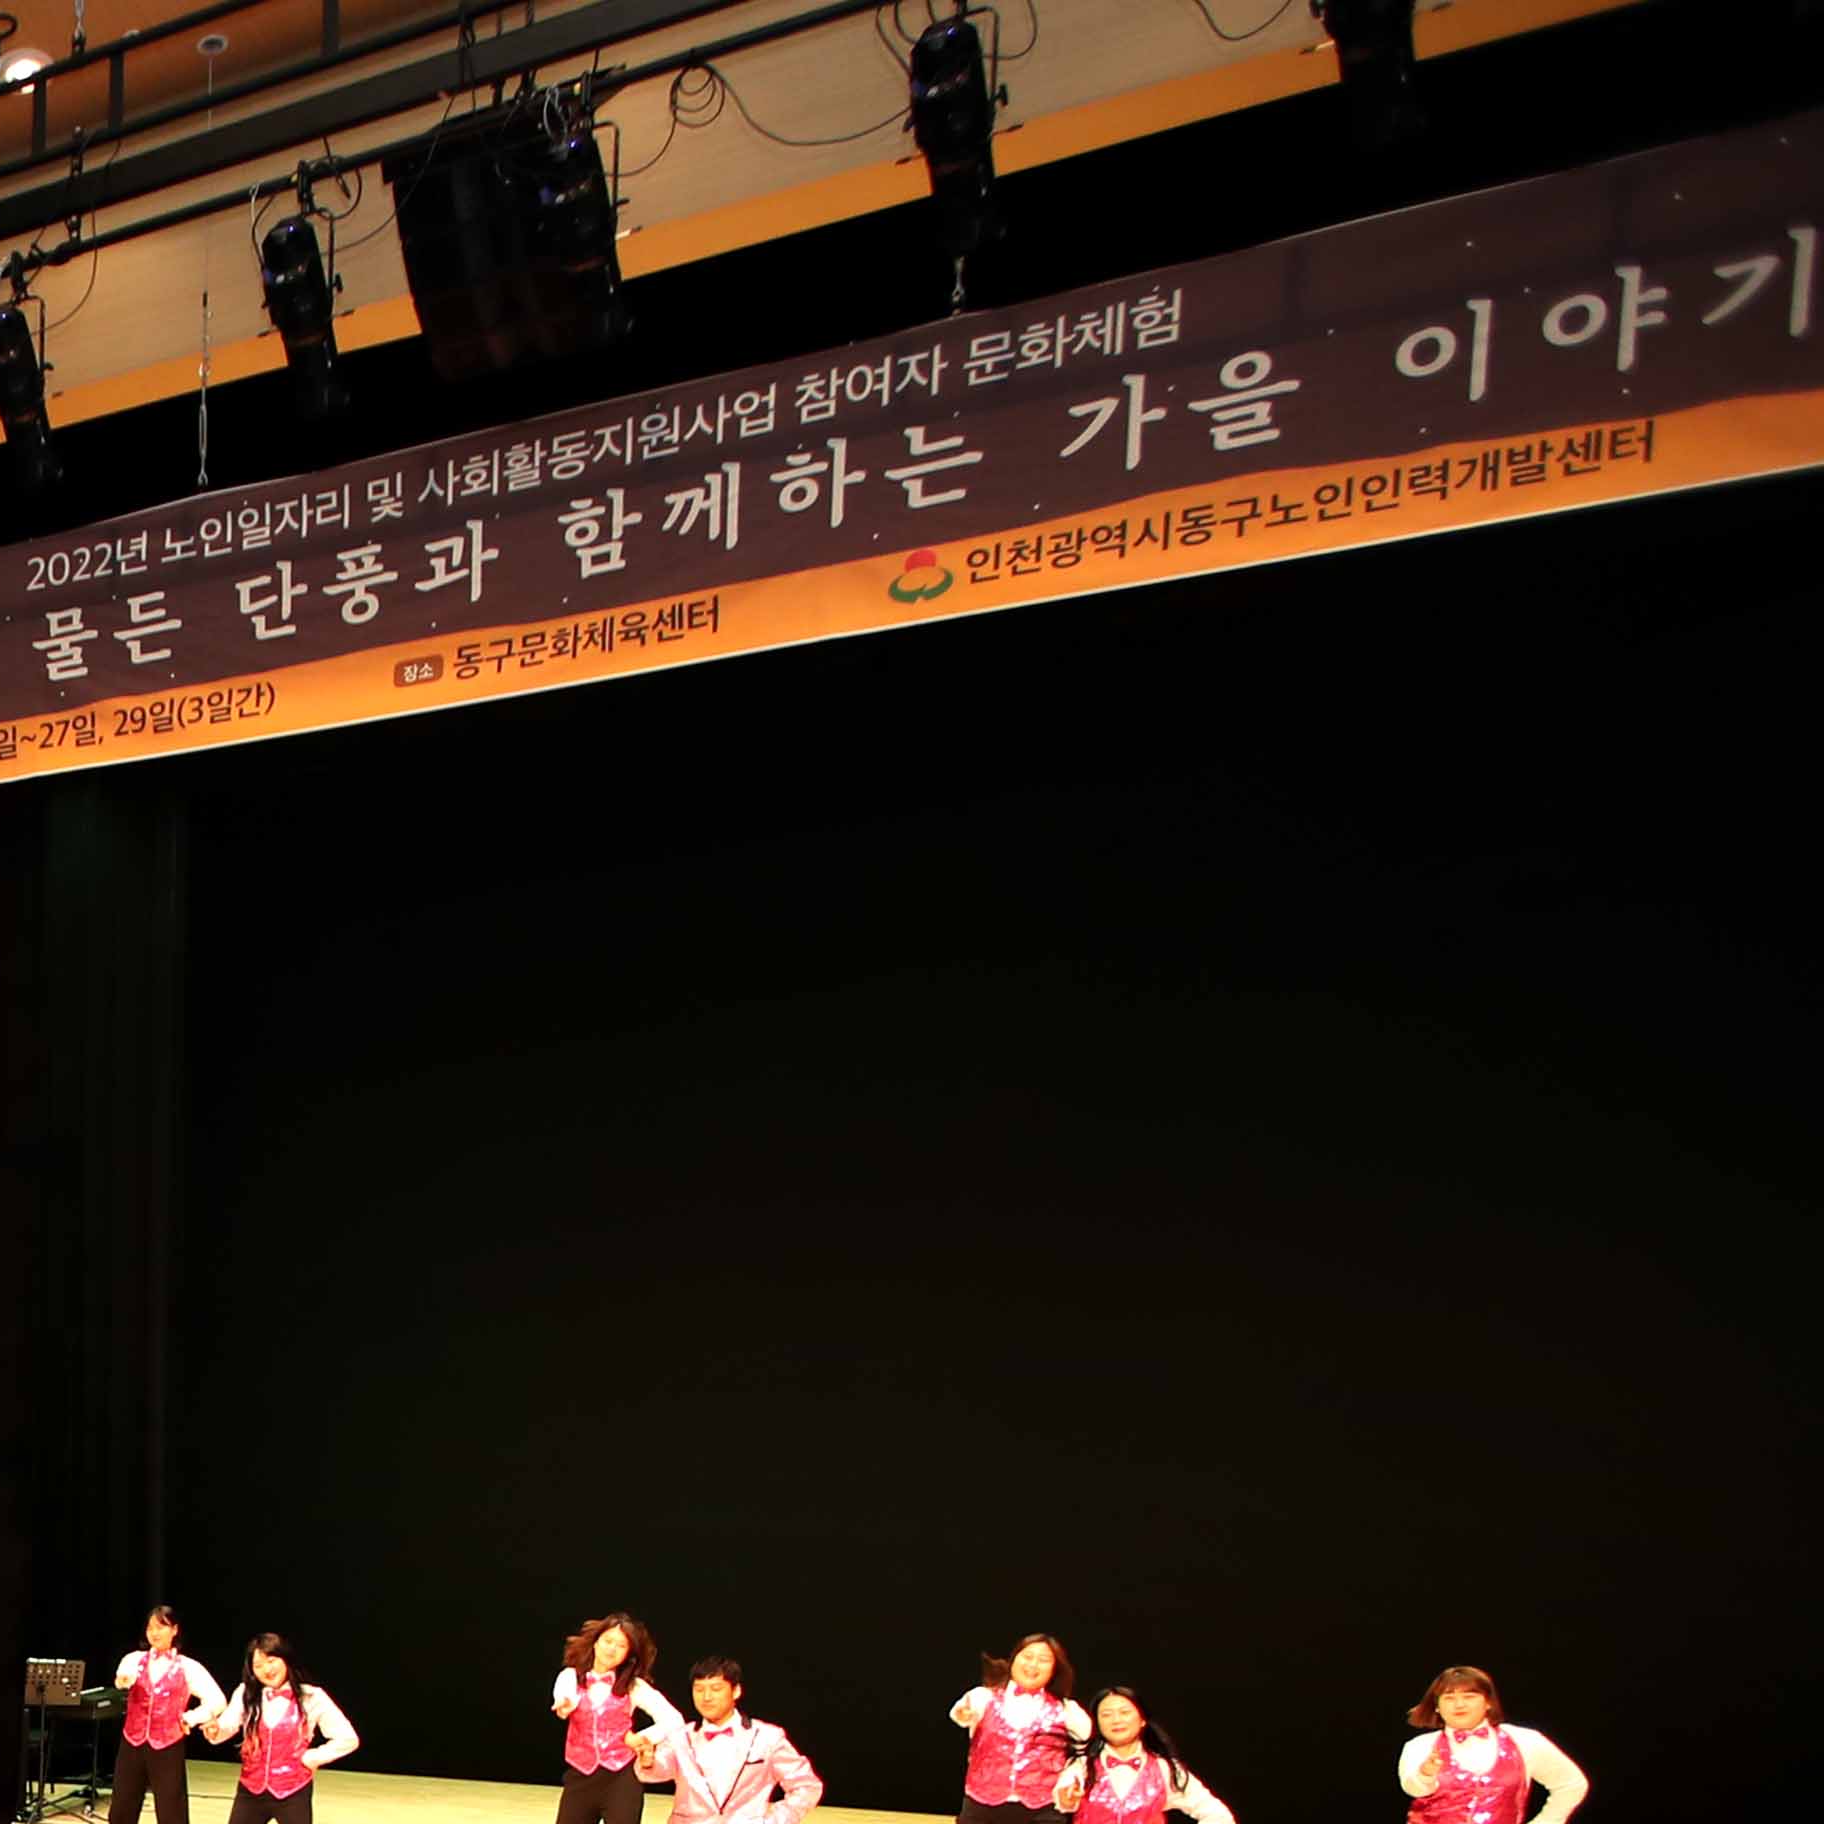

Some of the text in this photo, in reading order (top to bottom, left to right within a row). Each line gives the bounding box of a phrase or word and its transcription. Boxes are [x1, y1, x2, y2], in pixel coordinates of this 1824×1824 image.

[26, 287, 1184, 591] 2022년 노인일자리 및 사회활동지원사업 참여자 문화체험
[32, 591, 183, 682] 물든
[234, 519, 499, 641] 단풍과
[557, 425, 984, 579] 함께하는
[1059, 350, 1301, 471] 가을
[1394, 226, 1818, 403] 이야기
[113, 681, 276, 737] 29일(3일간)
[402, 595, 720, 683] 장소 동구문화체육센터
